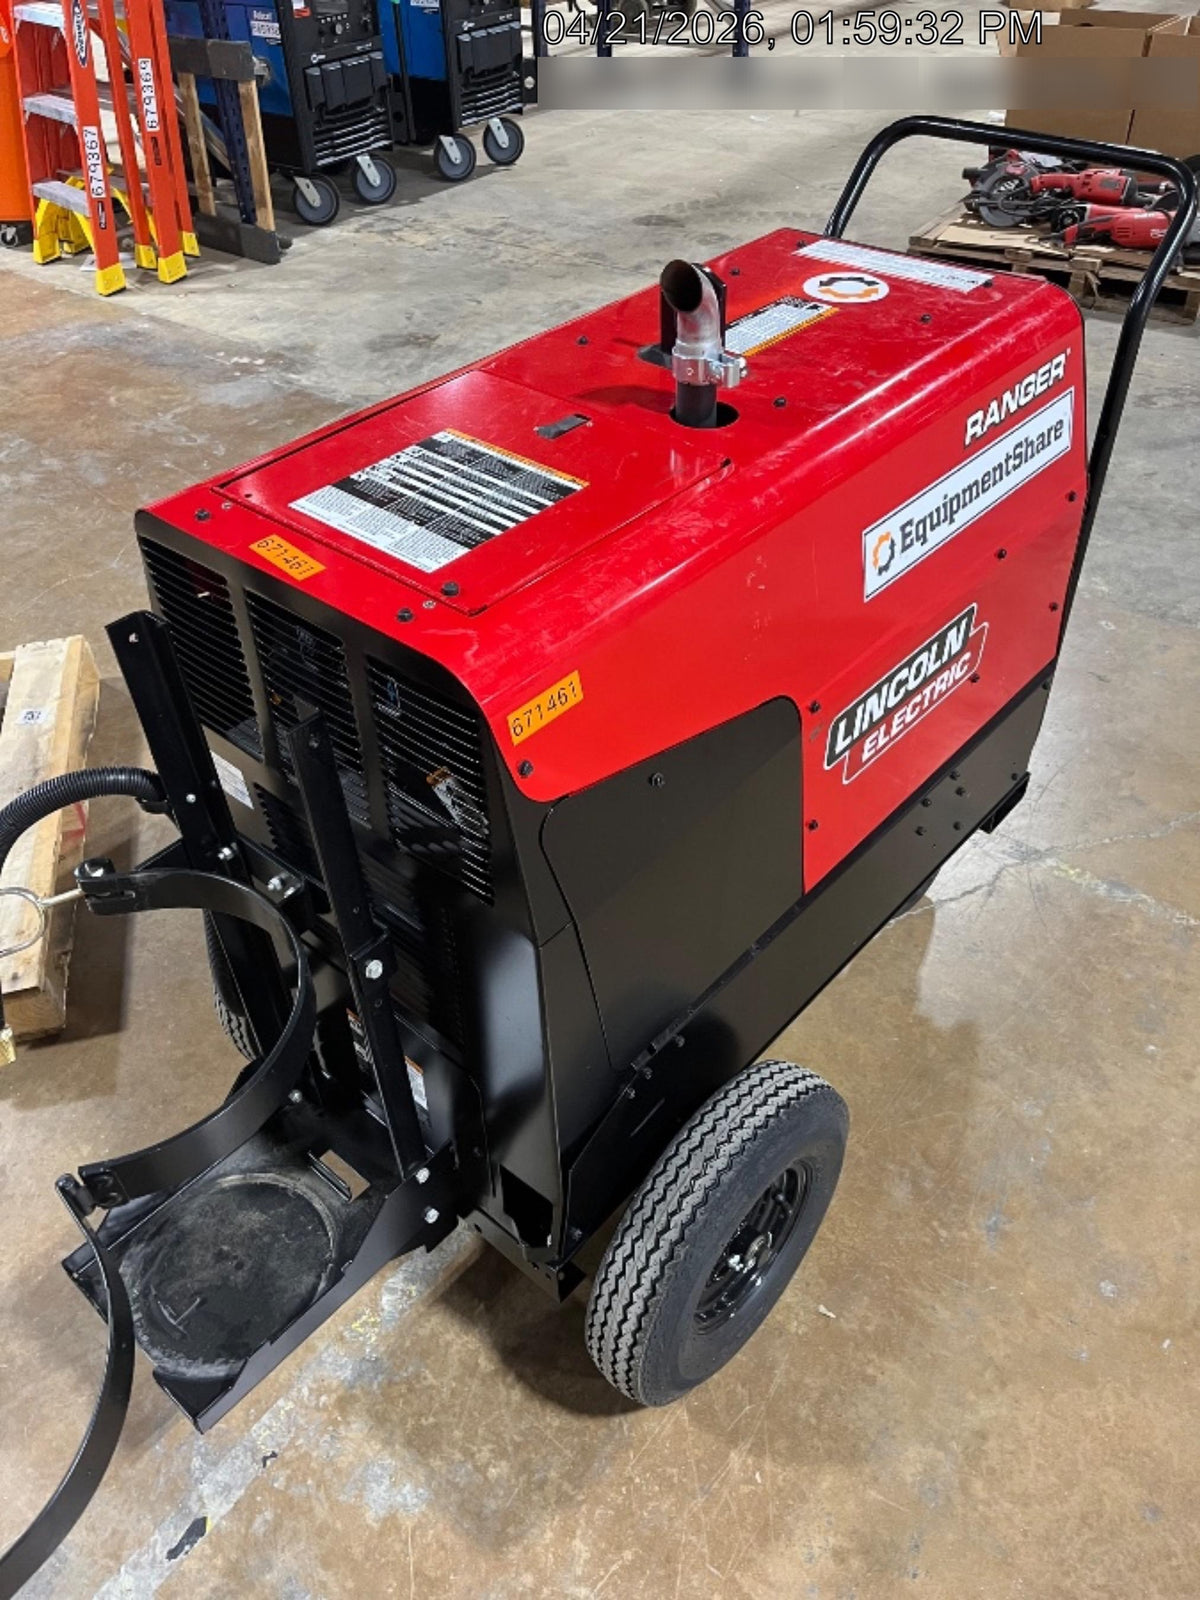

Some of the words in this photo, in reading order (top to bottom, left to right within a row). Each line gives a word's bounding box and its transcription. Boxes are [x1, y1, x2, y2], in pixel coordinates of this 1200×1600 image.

[84, 128, 106, 197] 679367
[964, 352, 1067, 447] RANGER
[899, 417, 1065, 554] EquipmentShare
[512, 680, 577, 737] 671461
[834, 616, 969, 755] LINCOLN
[861, 651, 972, 763] ELECTRIC
